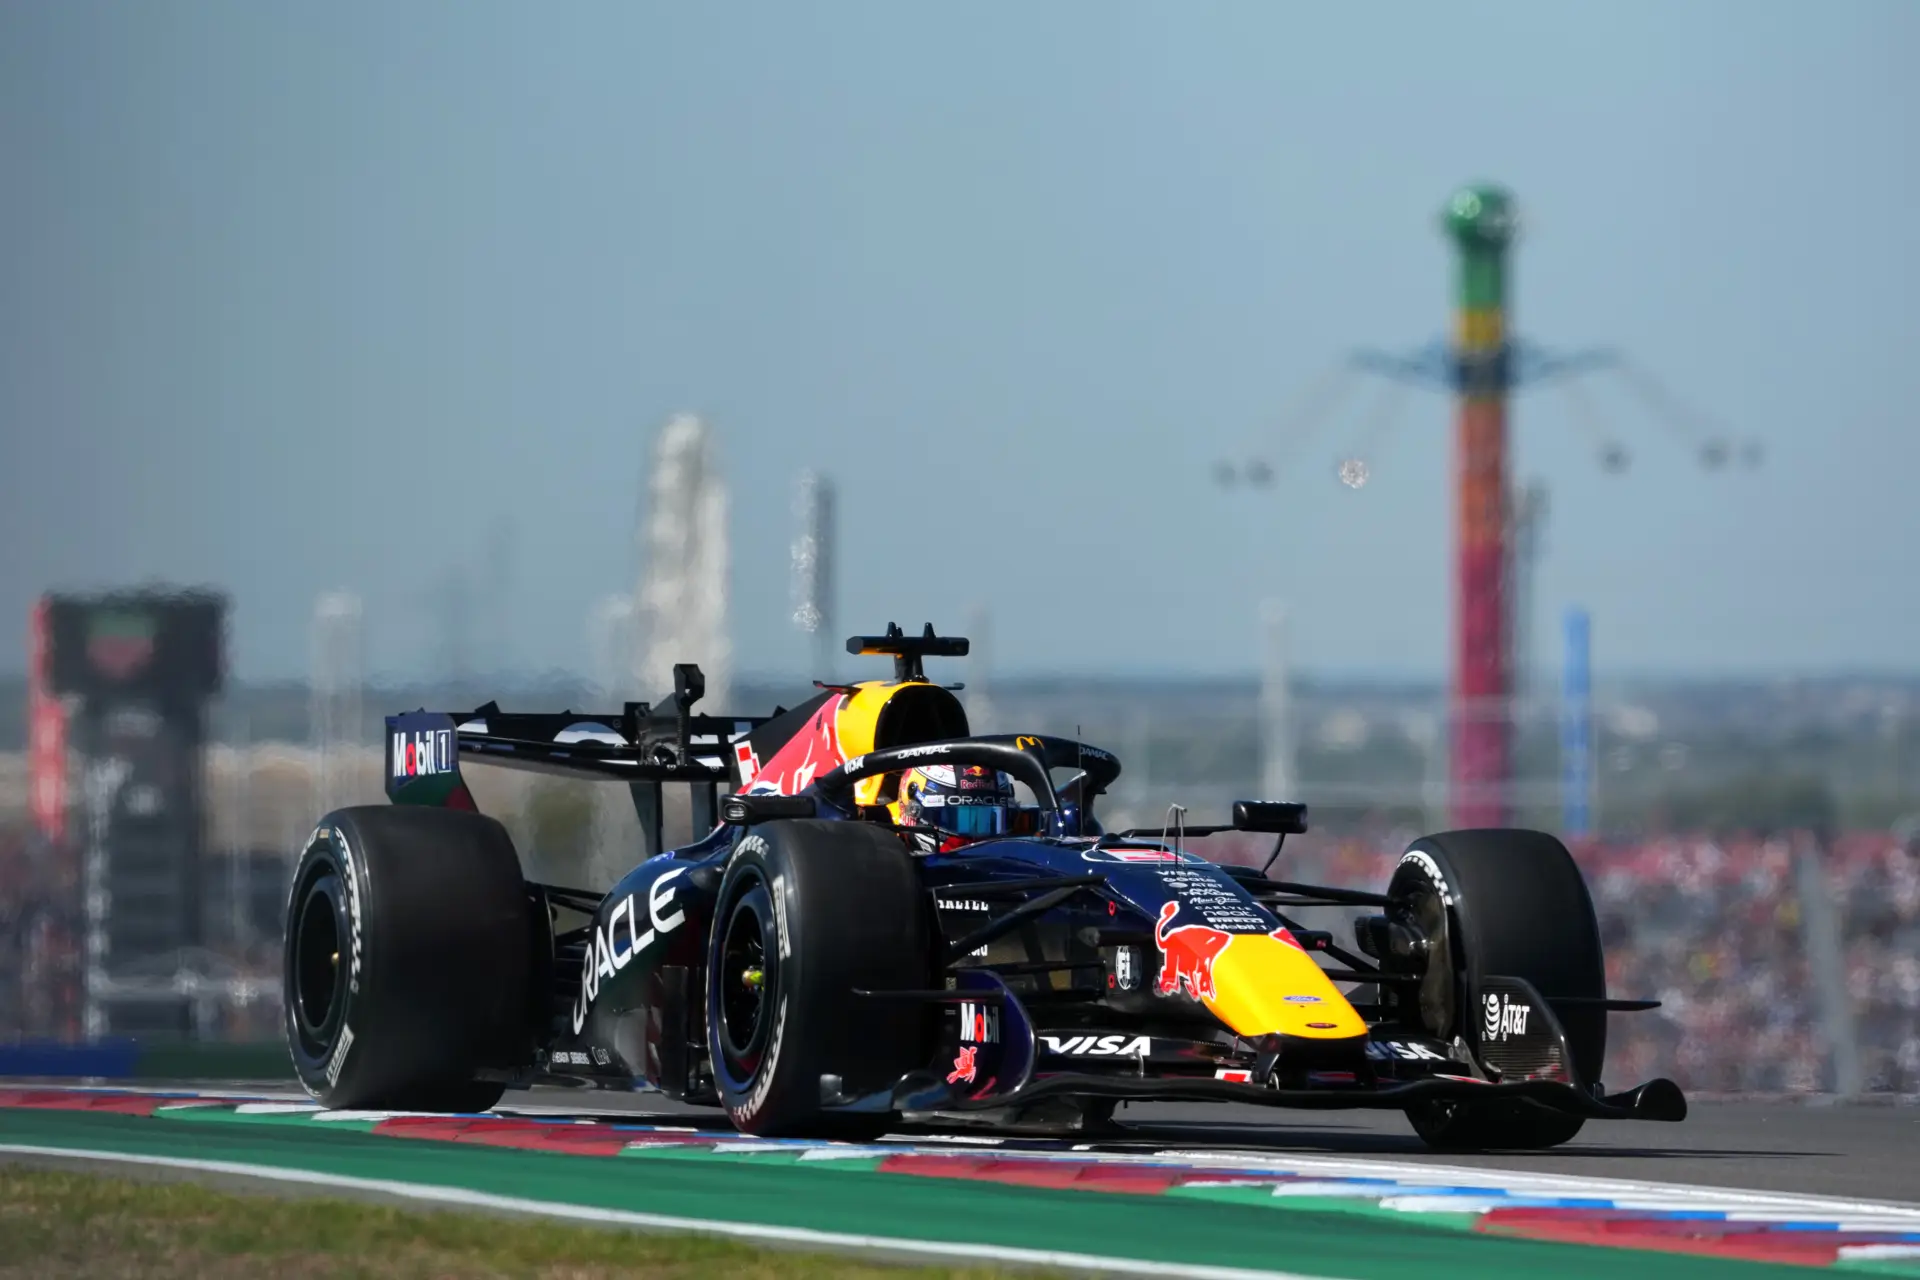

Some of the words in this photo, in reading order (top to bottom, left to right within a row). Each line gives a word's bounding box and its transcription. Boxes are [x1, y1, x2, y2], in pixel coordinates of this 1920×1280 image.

[393, 731, 436, 777] Mobil
[898, 744, 952, 759] DAMAC
[844, 756, 865, 774] VISA
[947, 795, 1009, 806] ORACLE
[960, 1002, 1000, 1044] Mobil
[1500, 1004, 1531, 1035] AT&T
[1037, 1035, 1151, 1056] VISA
